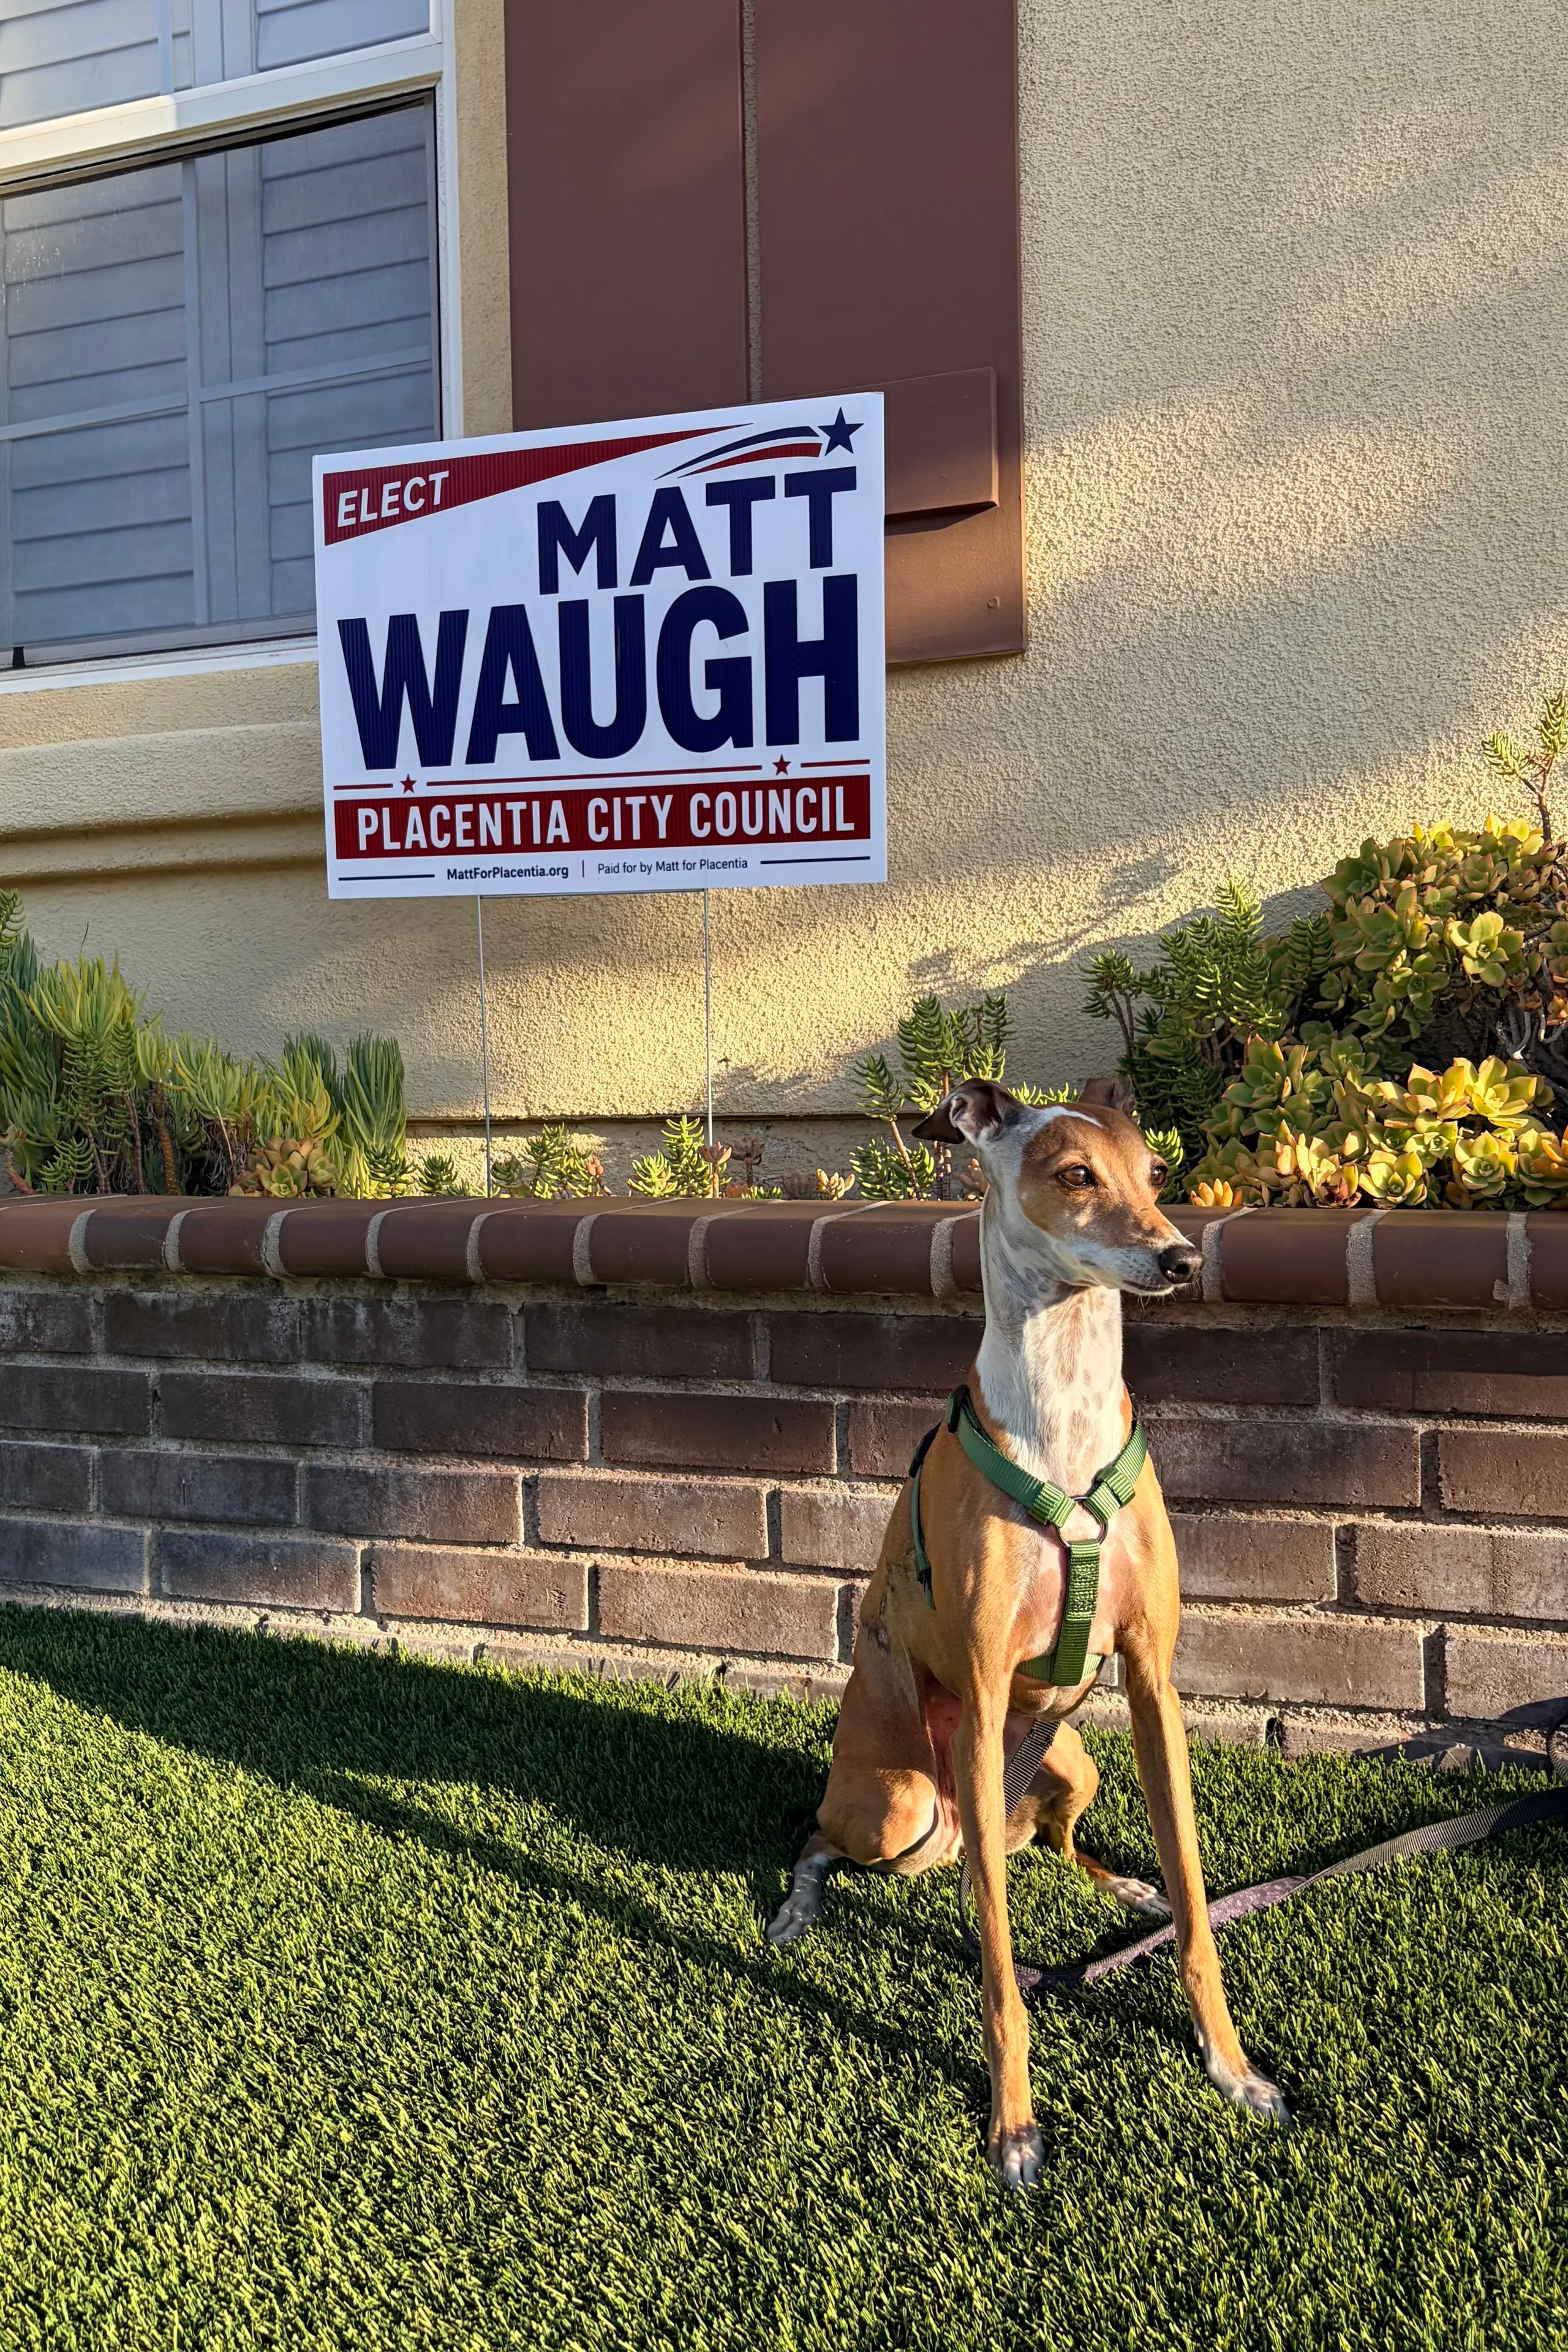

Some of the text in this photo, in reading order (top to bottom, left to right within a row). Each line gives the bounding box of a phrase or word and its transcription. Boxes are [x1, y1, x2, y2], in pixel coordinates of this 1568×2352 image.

[337, 470, 449, 527] ELECT
[537, 466, 858, 595] MATT
[337, 573, 861, 771] WAUGH
[358, 785, 855, 851] PLACENTIA CITY COUNCIL
[447, 865, 569, 879] MattForPlacentia.org
[598, 858, 748, 875] Paid for by Matt for Placentia
